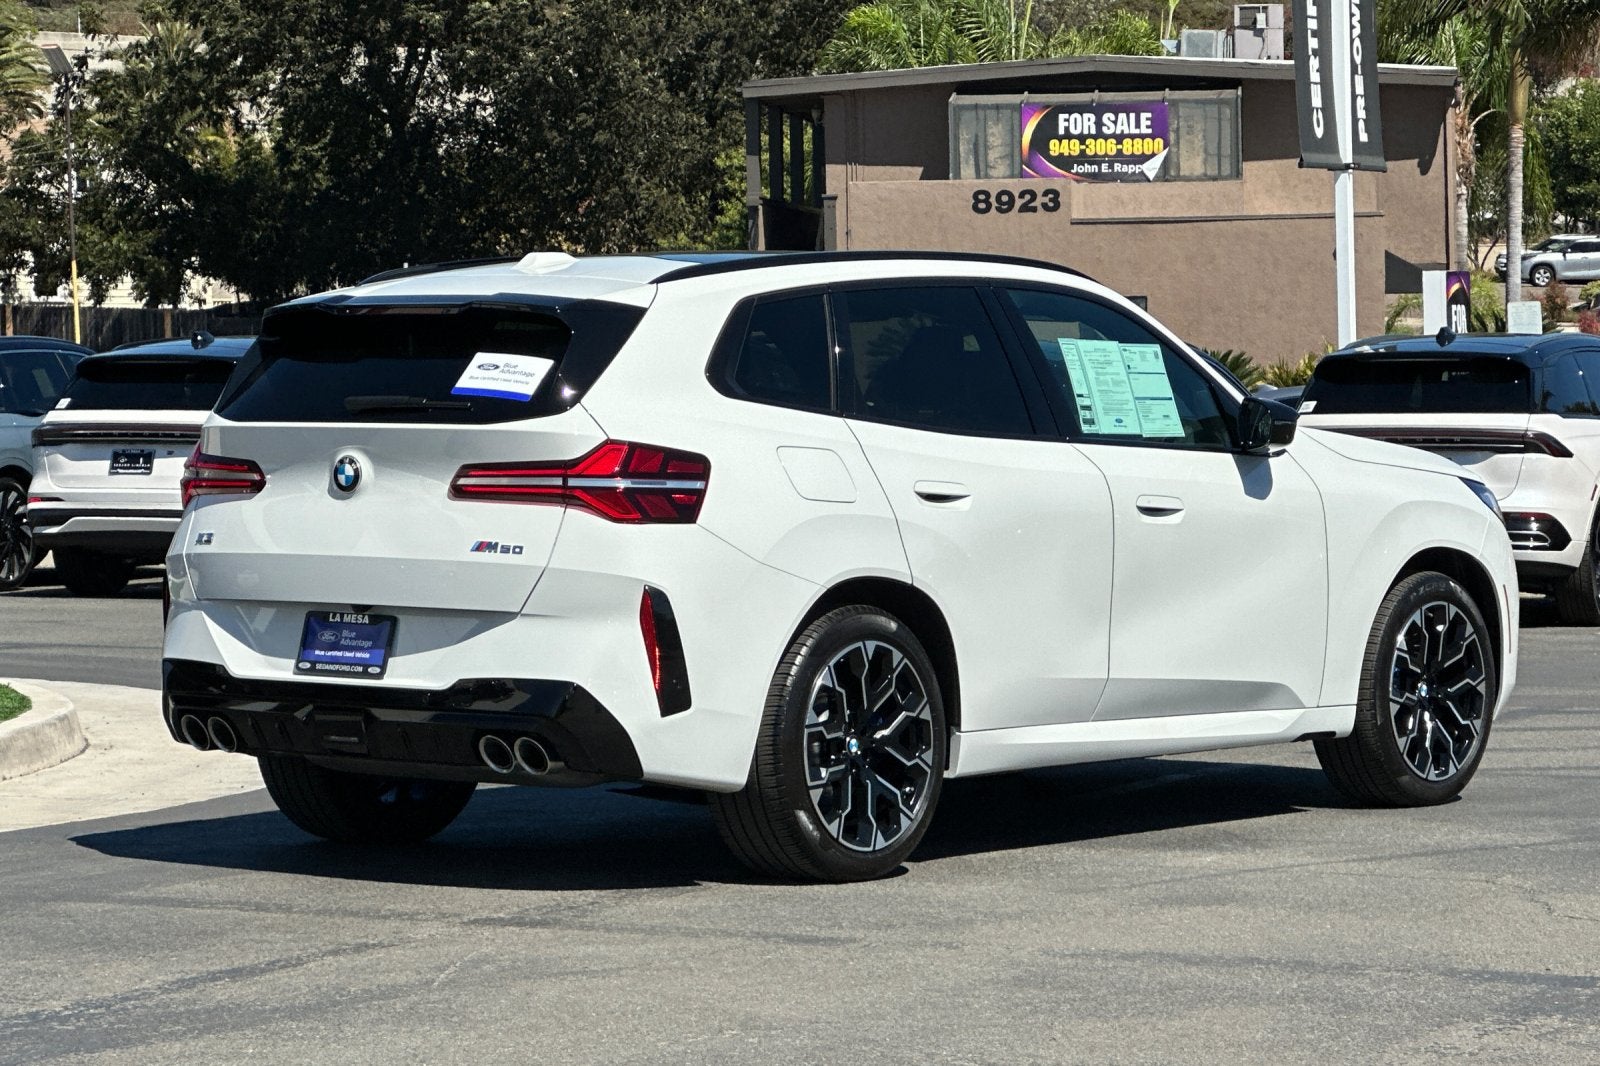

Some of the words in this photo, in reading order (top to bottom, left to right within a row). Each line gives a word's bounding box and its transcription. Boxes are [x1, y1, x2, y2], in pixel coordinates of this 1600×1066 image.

[1351, 0, 1368, 142] PRE-OW
[1058, 113, 1096, 136] FOR
[1102, 112, 1153, 135] SALE
[1049, 138, 1164, 157] 949-306-8800
[1071, 163, 1099, 174] John
[1101, 163, 1112, 173] E.
[971, 188, 1061, 215] 8923
[1451, 304, 1468, 334] FOR
[329, 612, 341, 622] LA
[343, 614, 369, 624] MESA
[341, 629, 356, 638] Blue
[340, 638, 373, 649] Advantage
